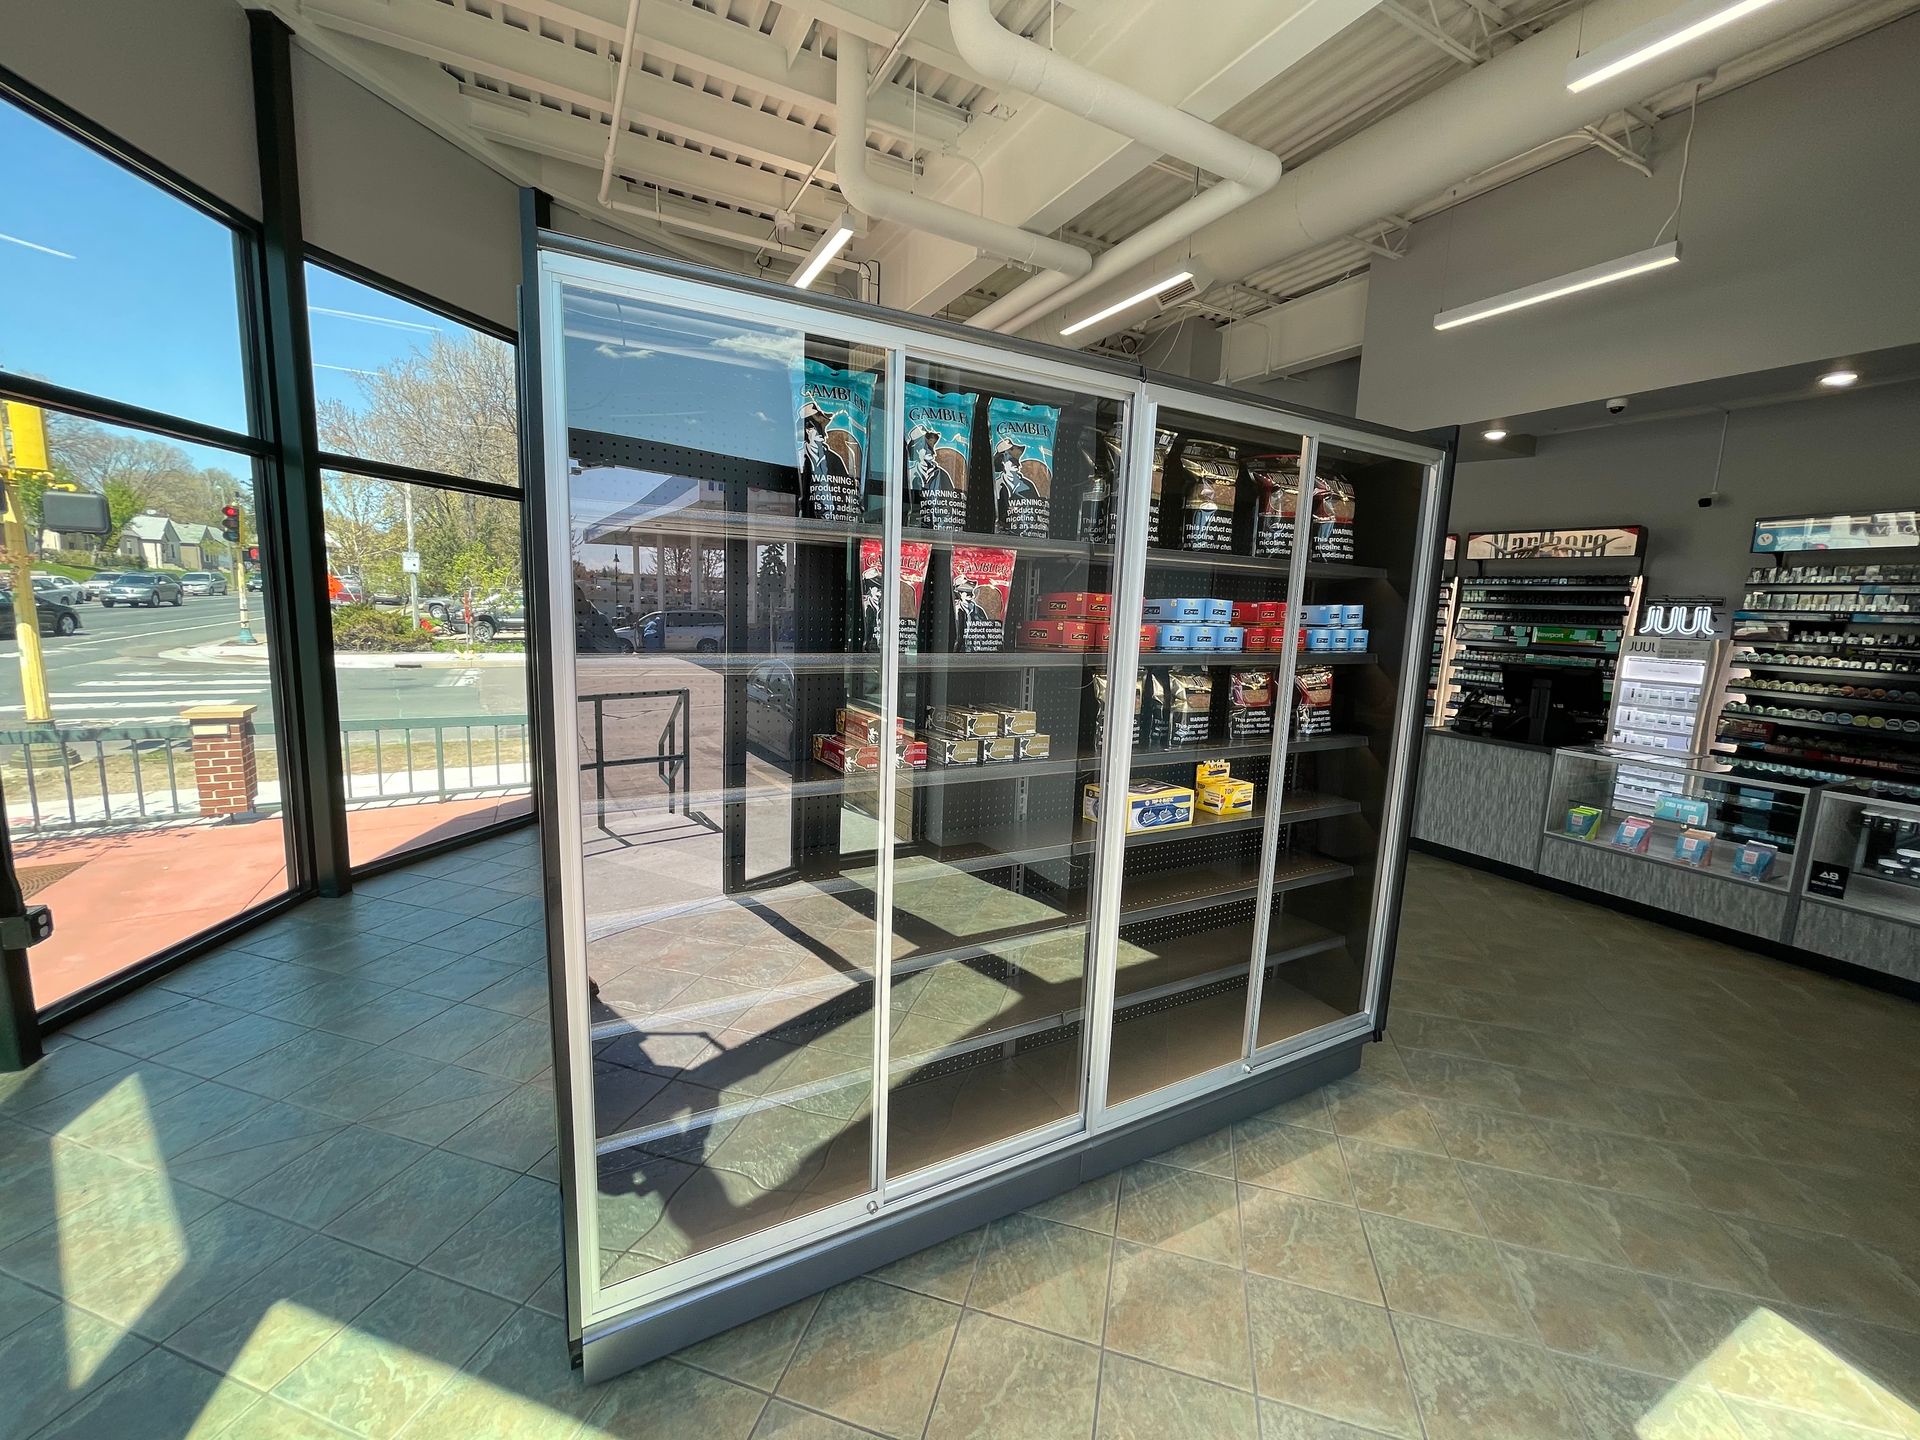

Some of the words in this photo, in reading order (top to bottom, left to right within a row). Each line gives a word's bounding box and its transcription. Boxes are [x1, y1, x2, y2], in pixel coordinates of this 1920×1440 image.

[811, 474, 854, 486] WARNING:
[810, 484, 841, 494] product
[809, 493, 844, 503] nicotine.
[921, 490, 960, 499] WARNING:
[814, 502, 822, 511] is
[824, 503, 836, 512] an
[920, 498, 948, 508] product
[1008, 499, 1044, 507] WARNING:
[919, 506, 950, 515] nicotine.
[1006, 506, 1034, 516] product
[1185, 523, 1200, 531] This
[1201, 525, 1226, 534] product
[1050, 602, 1067, 610] Zen
[1639, 605, 1715, 635] JUUL
[1030, 630, 1047, 638] Zen
[1629, 641, 1656, 653] JUUL
[1861, 759, 1878, 767] AND
[1879, 760, 1898, 769] SAVE
